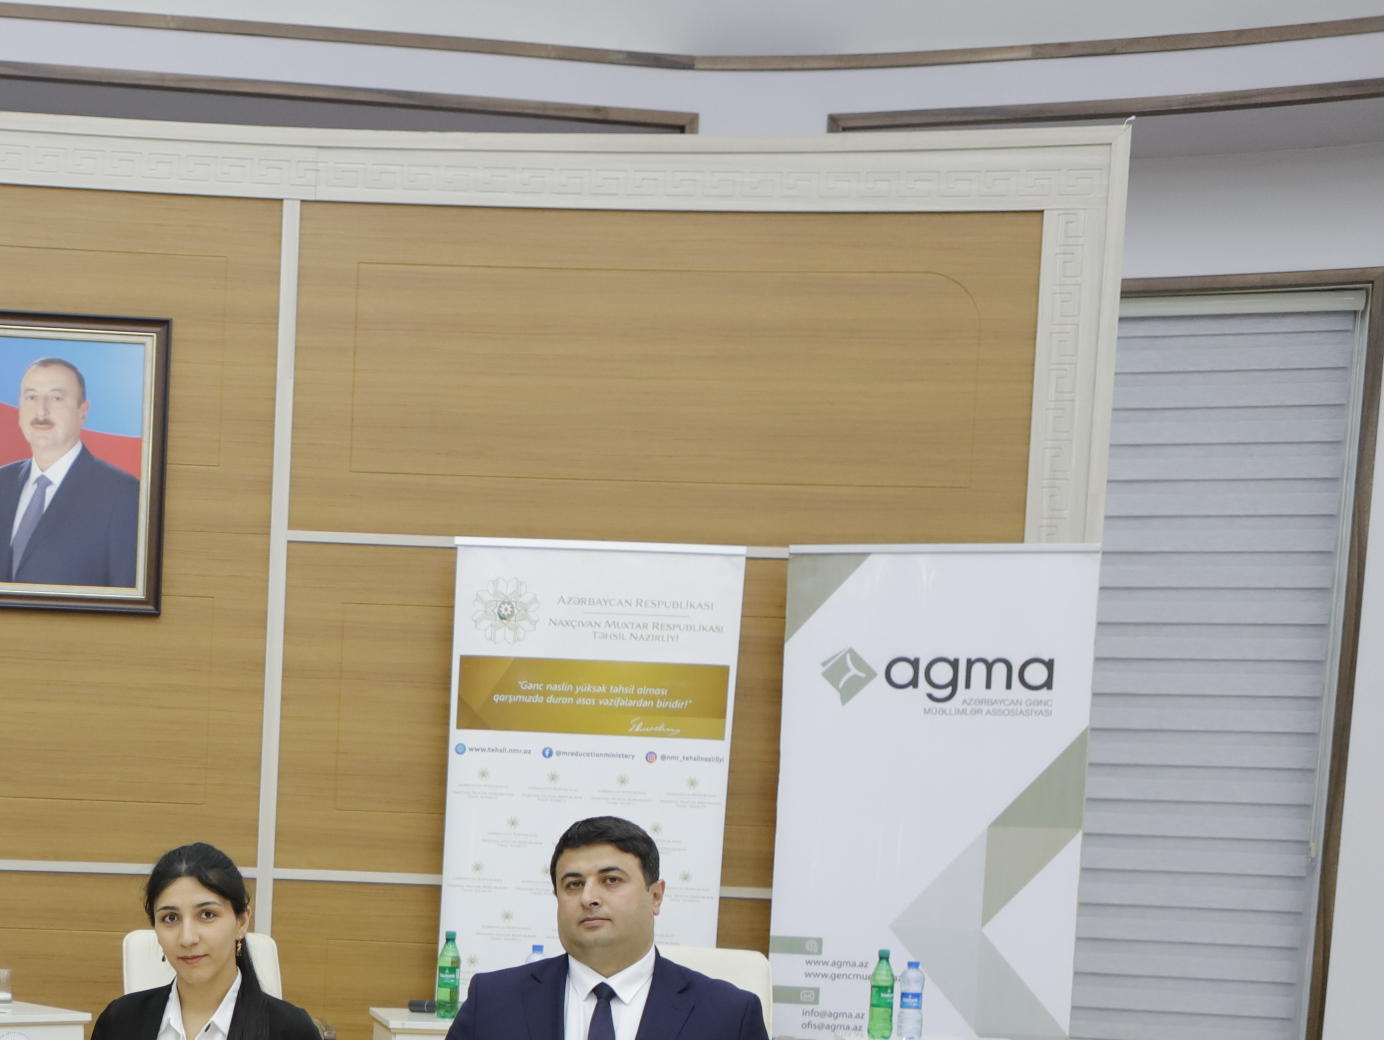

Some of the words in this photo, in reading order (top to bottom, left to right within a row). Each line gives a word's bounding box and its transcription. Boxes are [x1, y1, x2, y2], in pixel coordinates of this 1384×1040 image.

[557, 595, 632, 607] AZƏRBAYCAN
[635, 598, 714, 610] RESPUBLİKASI
[548, 618, 601, 630] NAXÇIVAN
[605, 620, 648, 630] MUXTAR
[652, 622, 724, 633] RESPUBLİKASI
[592, 631, 626, 641] TƏHSİL
[629, 632, 679, 643] NAZİRLİYİ
[884, 656, 1055, 703] agma
[546, 694, 573, 704] duran
[805, 959, 869, 969] www.agma.az
[802, 1008, 865, 1020] info@agma.az
[801, 1021, 863, 1032] ofis@agma.az
